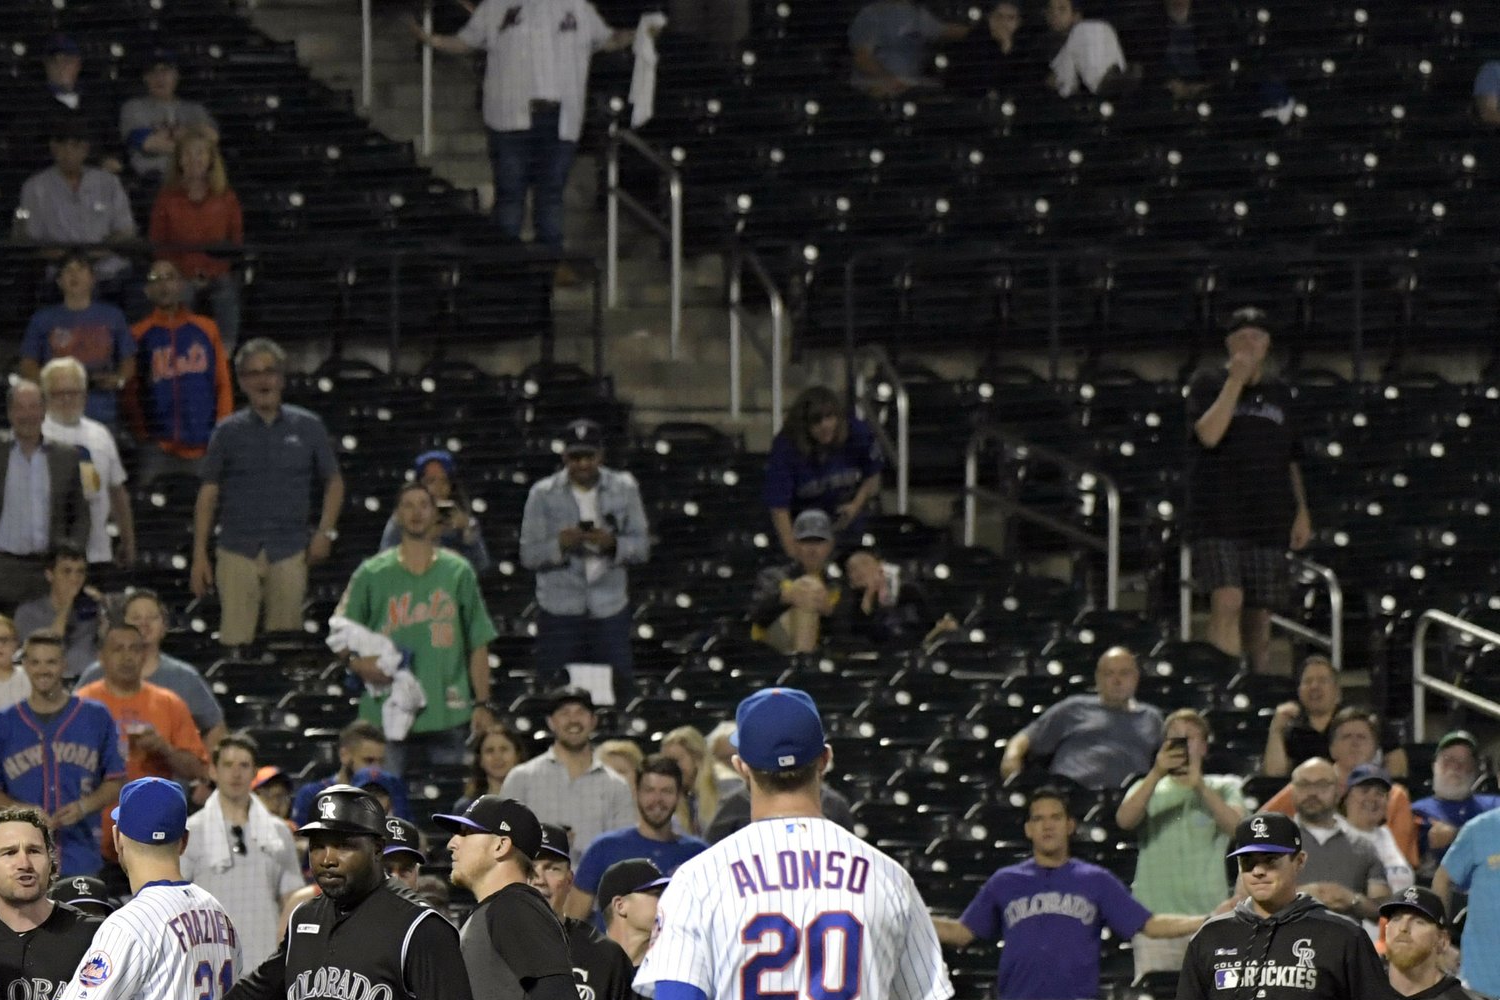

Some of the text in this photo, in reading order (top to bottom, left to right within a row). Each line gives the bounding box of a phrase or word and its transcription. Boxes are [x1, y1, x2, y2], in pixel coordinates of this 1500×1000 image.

[381, 589, 456, 636] Mets
[3, 741, 99, 780] NEW YORK
[730, 849, 870, 898] ALONSO
[168, 908, 236, 953] FRAZIER
[1003, 891, 1099, 928] COLORADO
